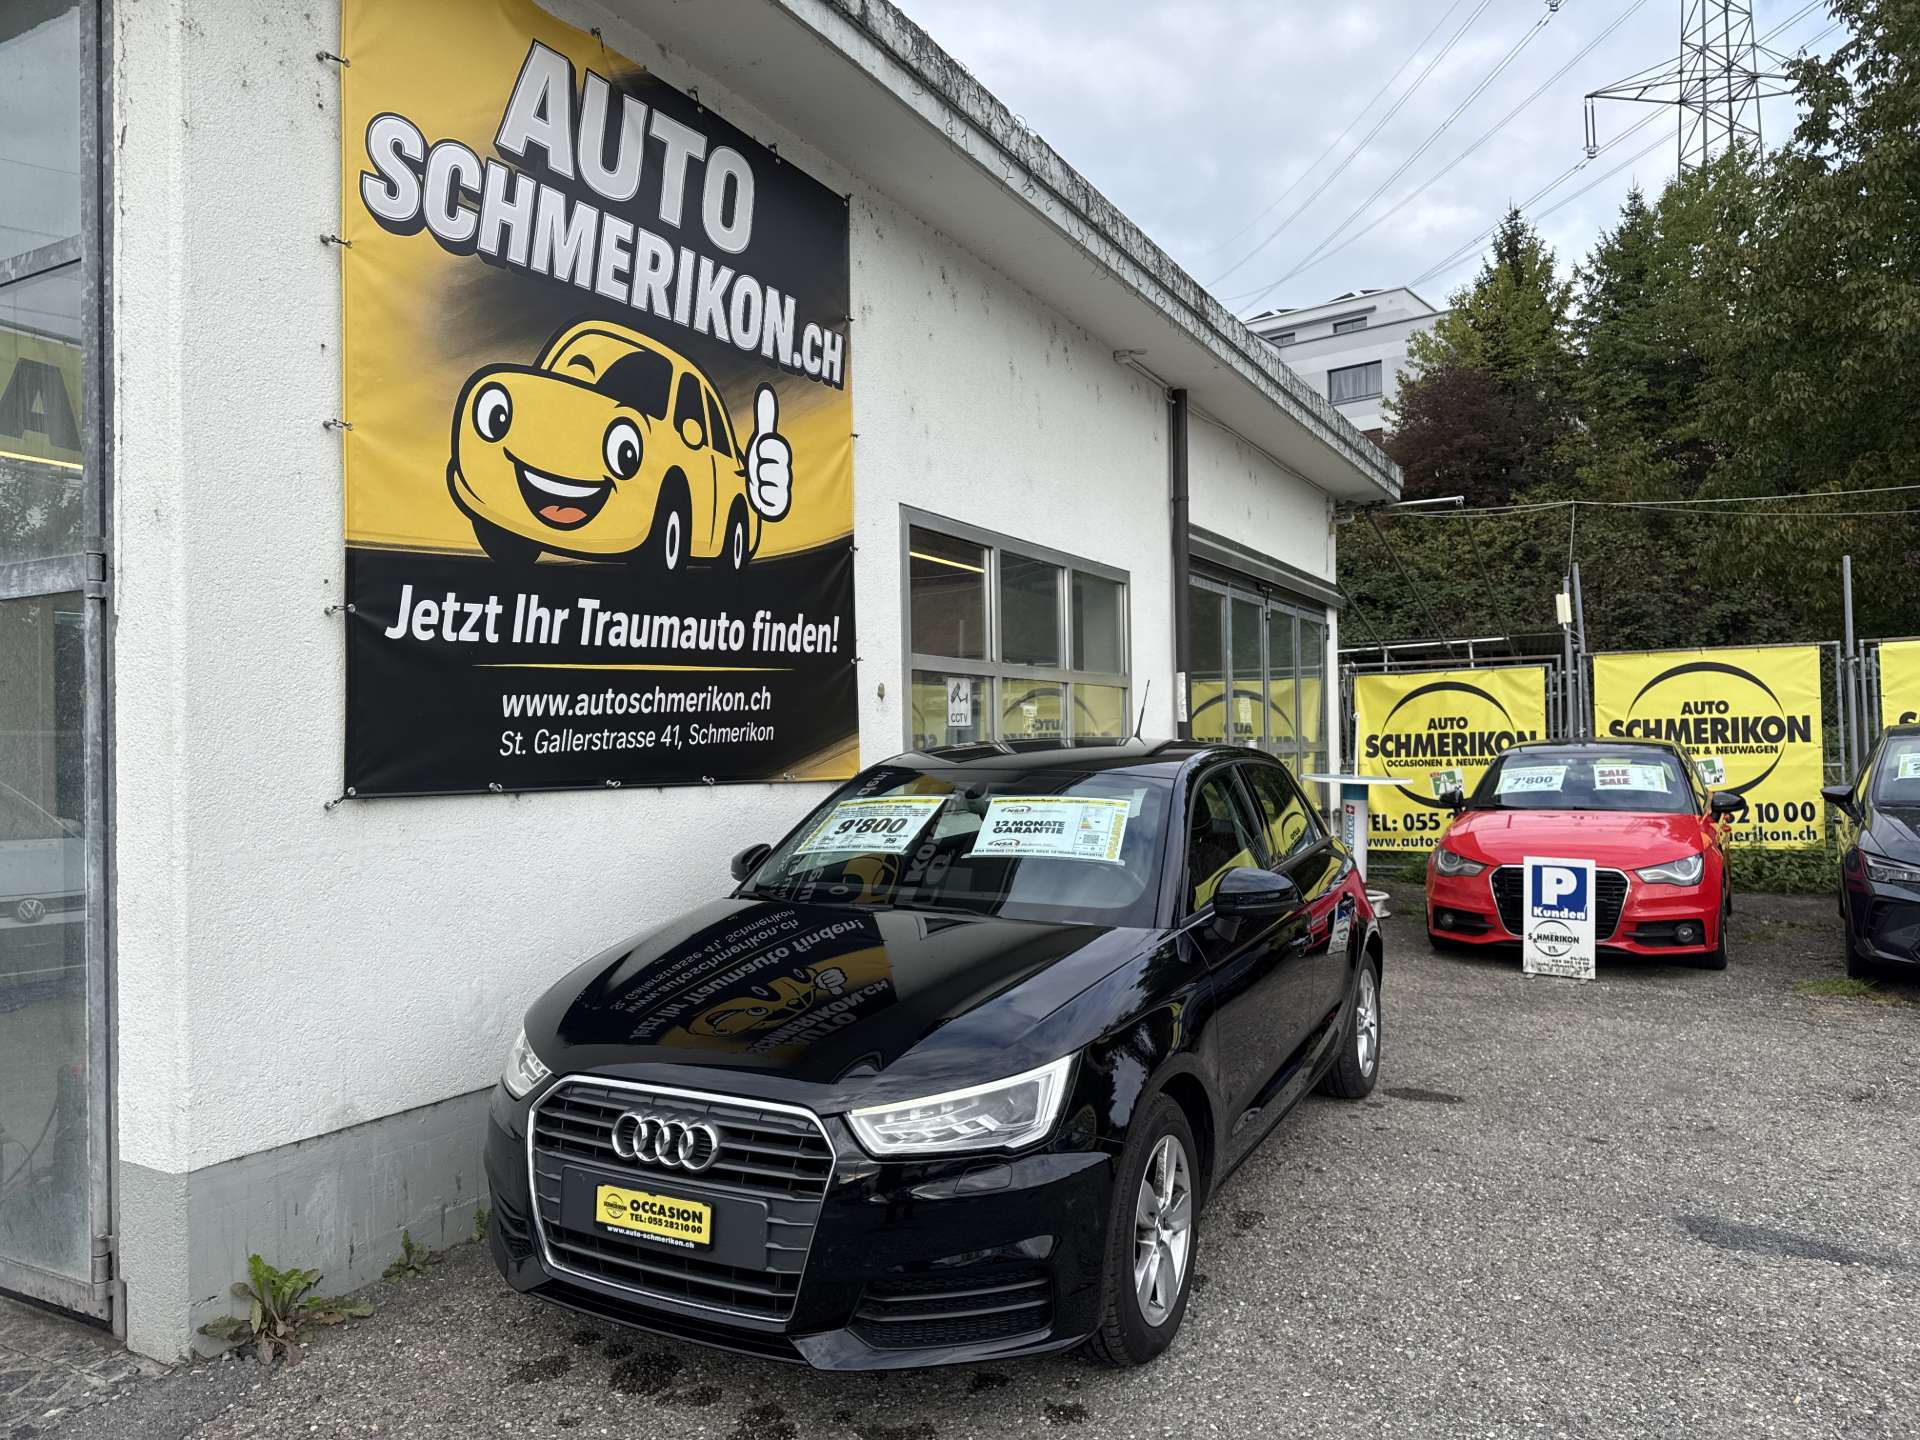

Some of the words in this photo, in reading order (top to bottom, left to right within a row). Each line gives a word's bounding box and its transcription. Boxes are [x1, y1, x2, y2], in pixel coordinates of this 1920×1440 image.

[495, 41, 755, 254] AUTO
[361, 113, 846, 386] SCHMERIKON.CH
[385, 584, 502, 642] Jetzt
[512, 593, 569, 645] Ihr
[577, 598, 745, 651] Traumauto
[751, 610, 839, 654] finden!
[502, 686, 771, 718] www.autoschmerikon.ch
[1681, 700, 1729, 715] AUTO
[951, 712, 968, 724] CCTV
[1427, 717, 1468, 730] AUTO
[1609, 715, 1812, 744] SCHMERIKON
[499, 729, 527, 757] St.
[534, 726, 656, 755] Gallerstrasse
[660, 725, 684, 751] 41,
[688, 722, 775, 746] Schmerikon
[1704, 746, 1712, 755] &
[1716, 745, 1778, 755] NEUWAGEN
[1386, 759, 1442, 767] OCCASIONEN
[1446, 759, 1453, 767] &
[1513, 776, 1554, 785] 7'800
[1598, 769, 1630, 777] SALE
[1599, 778, 1631, 786] SALE
[1784, 801, 1816, 823] 00
[834, 818, 908, 835] 9'800
[992, 827, 1065, 835] GARANTIE
[1011, 820, 1066, 829] MONATE
[1403, 813, 1441, 832] 055
[1542, 867, 1577, 905] P
[1533, 906, 1586, 920] Kunden
[1528, 932, 1580, 945] SHMERIKON
[630, 1199, 703, 1224] OCCASION
[630, 1213, 647, 1223] TEL:
[648, 1216, 663, 1226] 055
[664, 1220, 680, 1230] 282
[691, 1225, 703, 1234] 00
[606, 1225, 695, 1249] www.auto-schmerikon.ch
